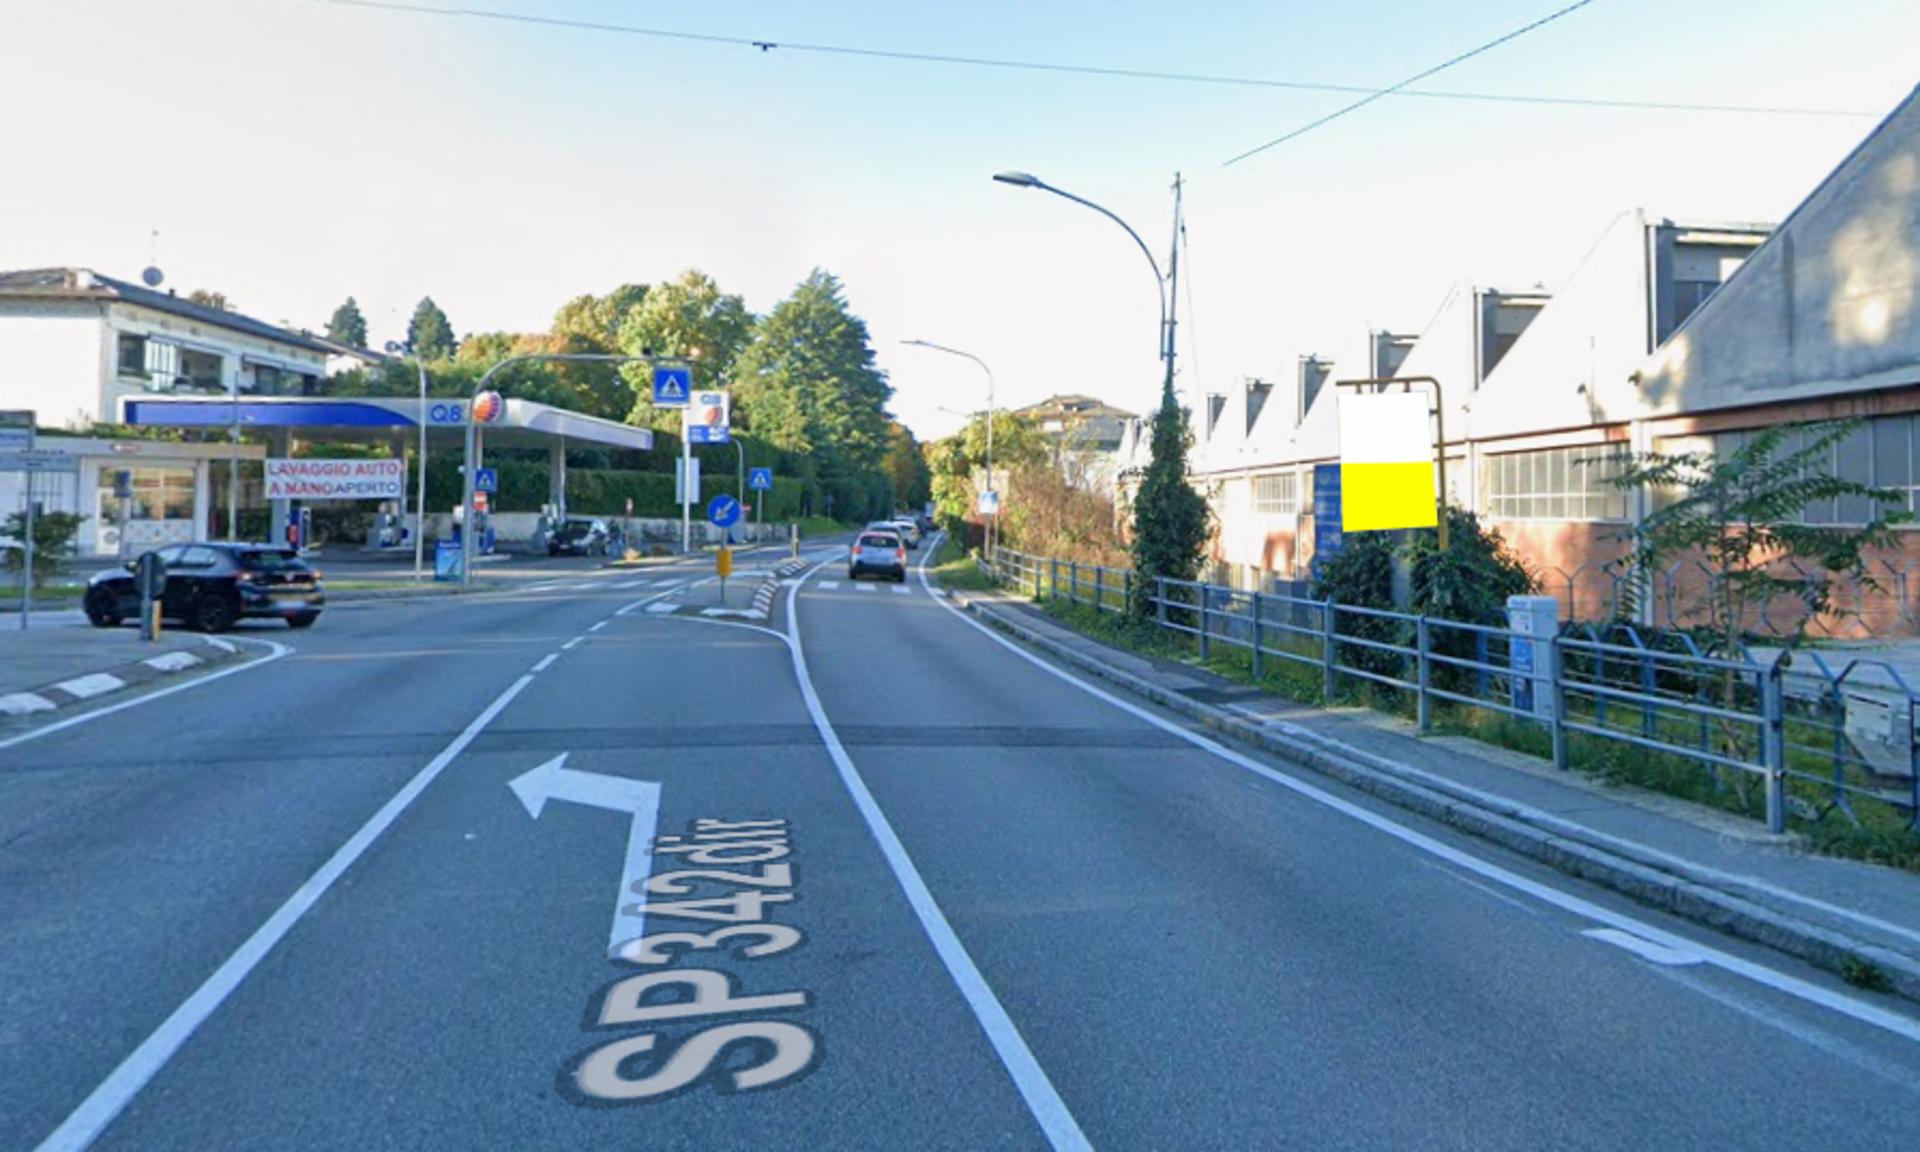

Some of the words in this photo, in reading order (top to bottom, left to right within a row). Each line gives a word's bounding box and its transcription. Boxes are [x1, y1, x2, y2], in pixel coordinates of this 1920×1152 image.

[430, 404, 461, 423] Q8
[268, 462, 351, 475] LAVAGGIO
[355, 462, 398, 475] AUTO
[271, 481, 280, 495] A
[335, 481, 399, 494] APERTO
